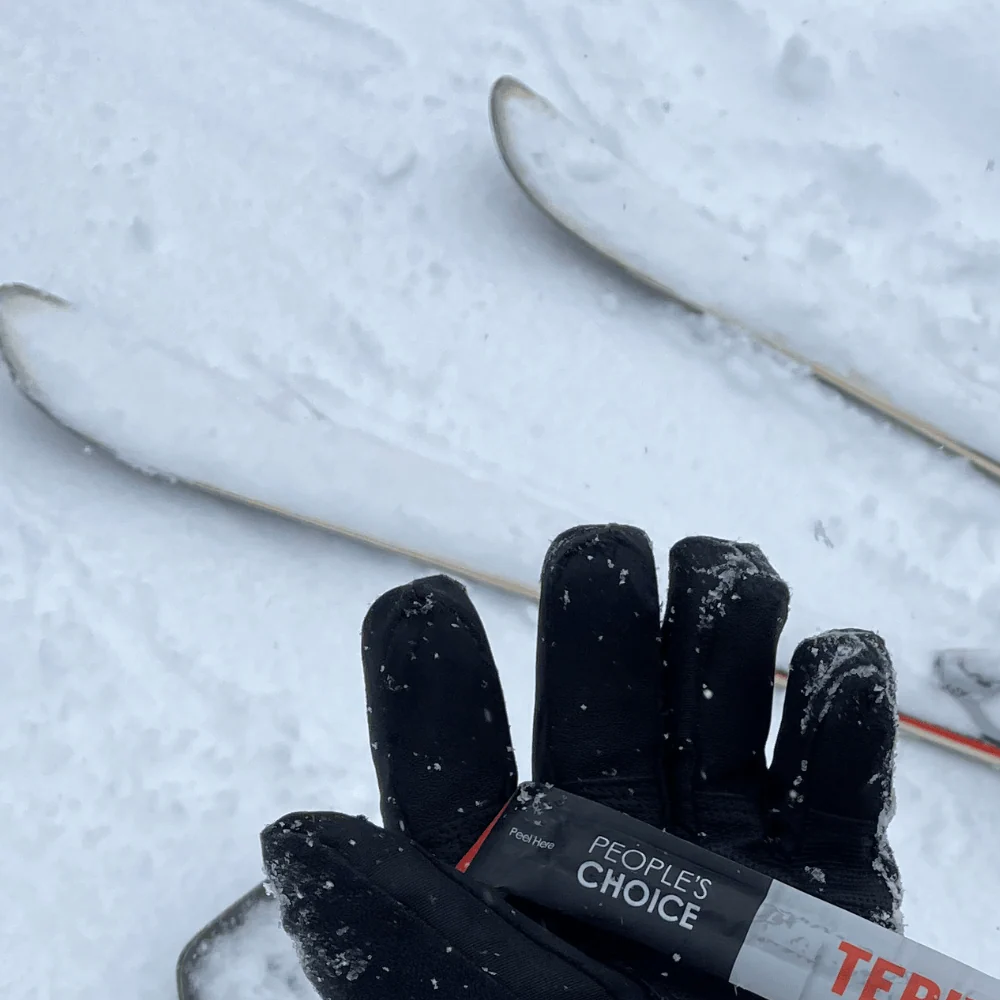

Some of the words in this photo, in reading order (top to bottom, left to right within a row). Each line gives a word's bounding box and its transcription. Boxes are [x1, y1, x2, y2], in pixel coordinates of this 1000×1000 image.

[508, 826, 532, 843] Peel
[531, 835, 555, 850] Here
[589, 835, 712, 900] PEOPLE'S
[577, 861, 701, 930] CHOICE
